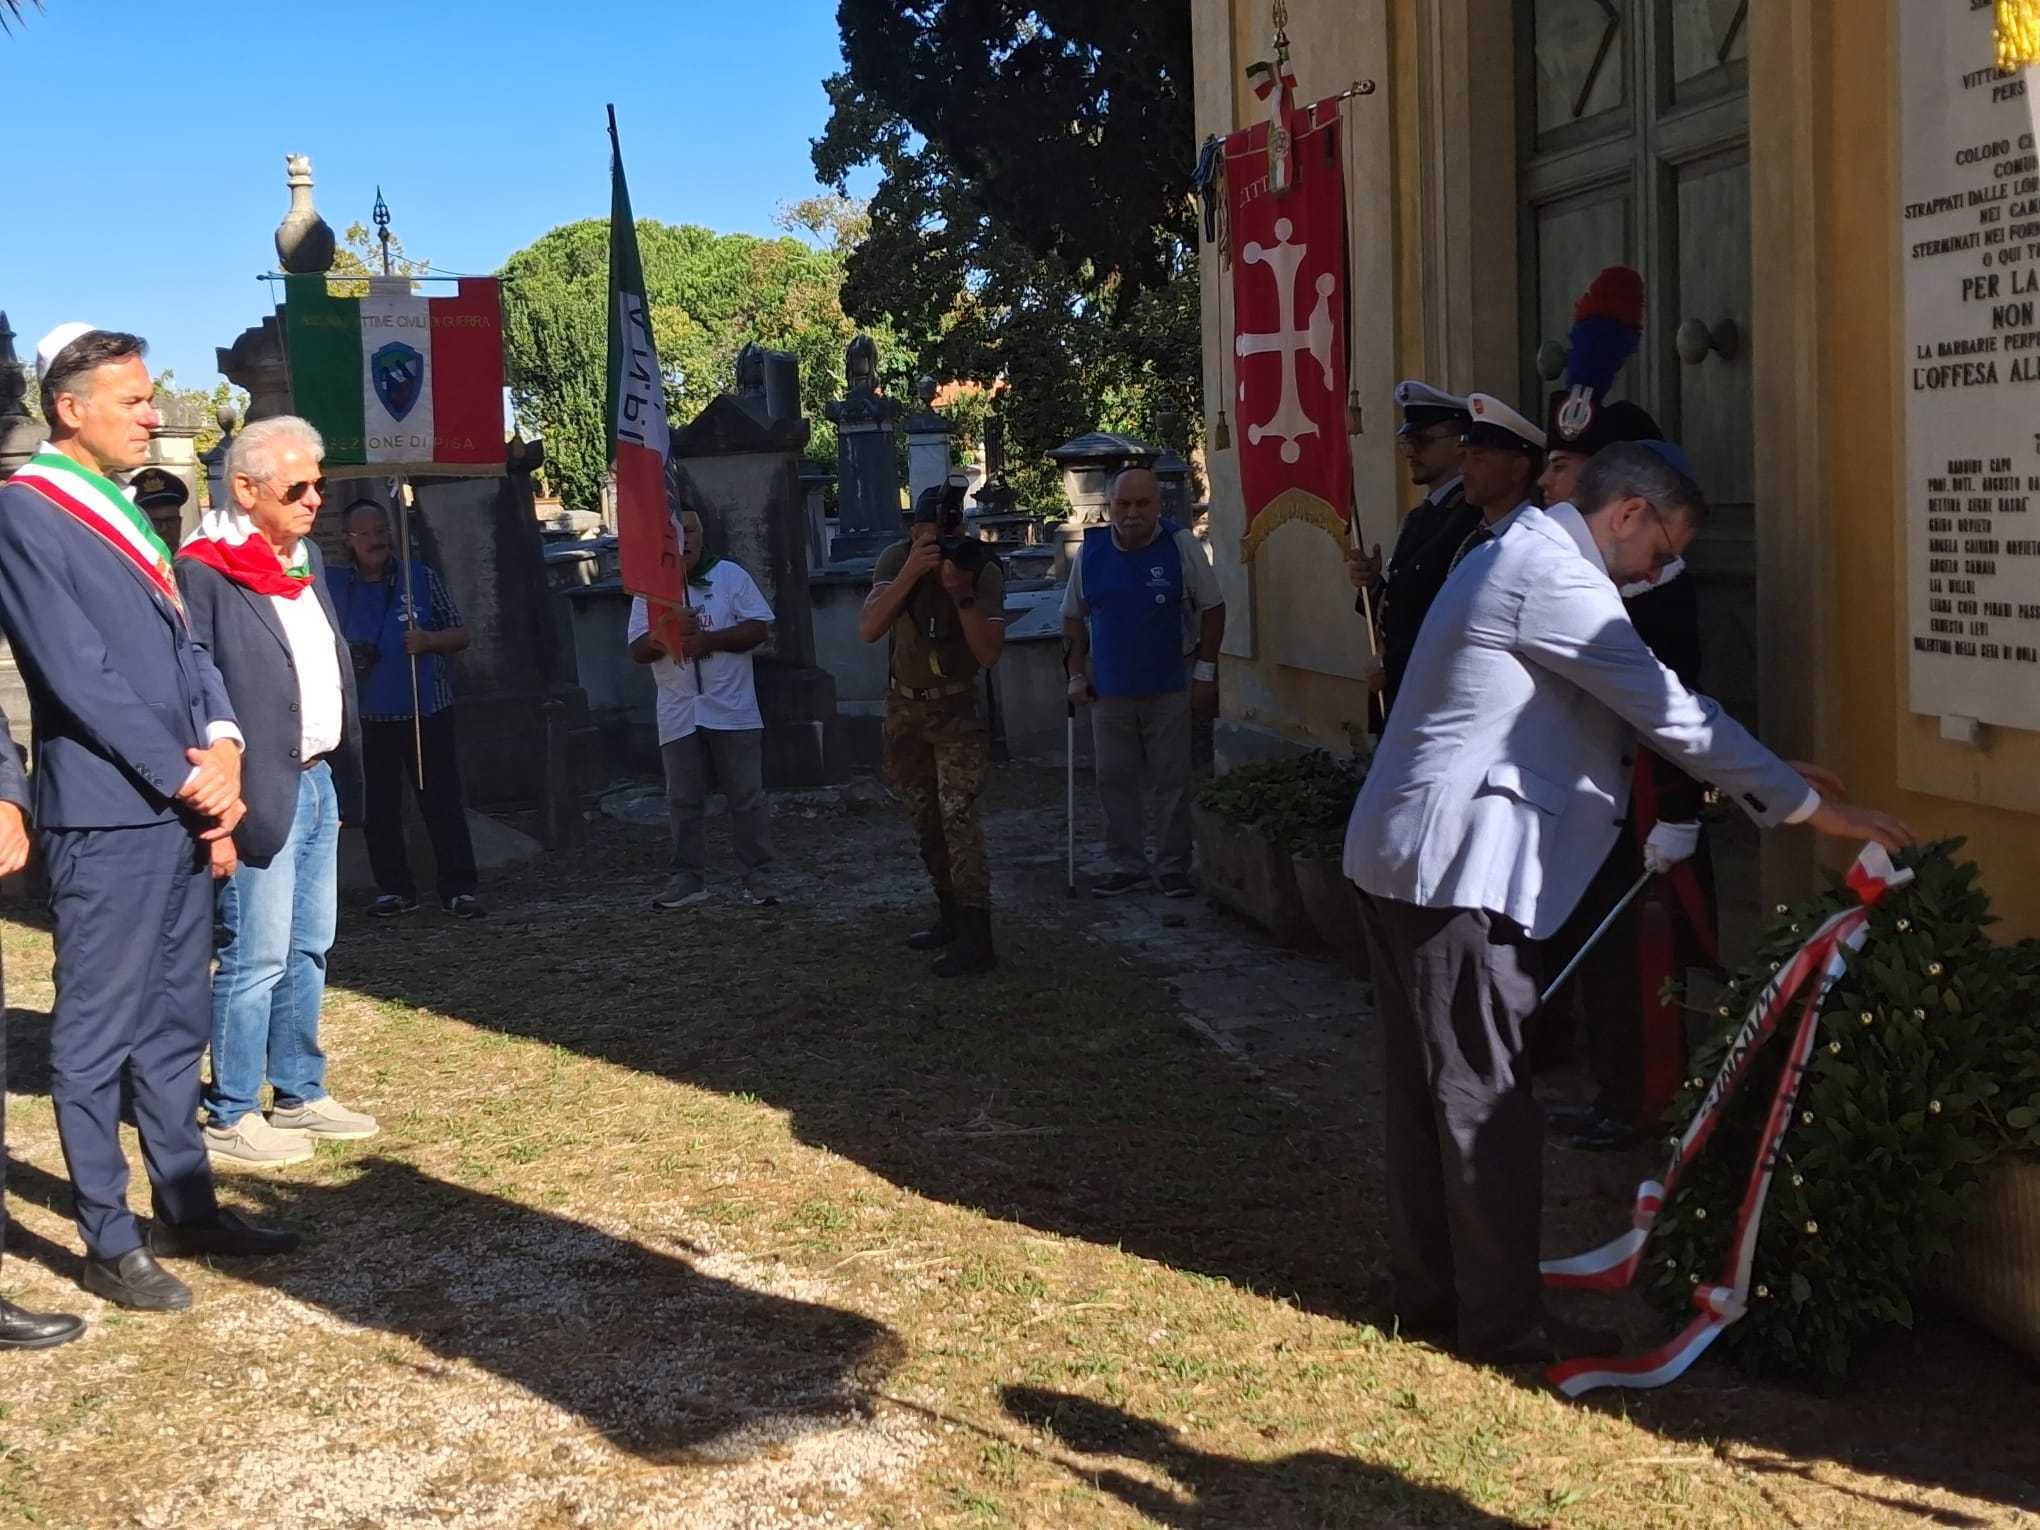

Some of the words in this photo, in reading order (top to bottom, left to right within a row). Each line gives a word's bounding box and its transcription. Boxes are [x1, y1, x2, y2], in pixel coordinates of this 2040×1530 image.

[1968, 182, 2008, 206] DALLE
[1980, 206, 2001, 224] NEI
[1912, 231, 1980, 259] STERMINATI
[1984, 227, 2005, 246] NEI
[1998, 246, 2022, 266] QUI
[1962, 273, 2000, 302] PER
[2011, 268, 2040, 295] LA
[1991, 301, 2033, 330] NON
[1917, 344, 1932, 360] LA
[1938, 336, 1998, 358] BARBARIE
[409, 435, 427, 449] DI
